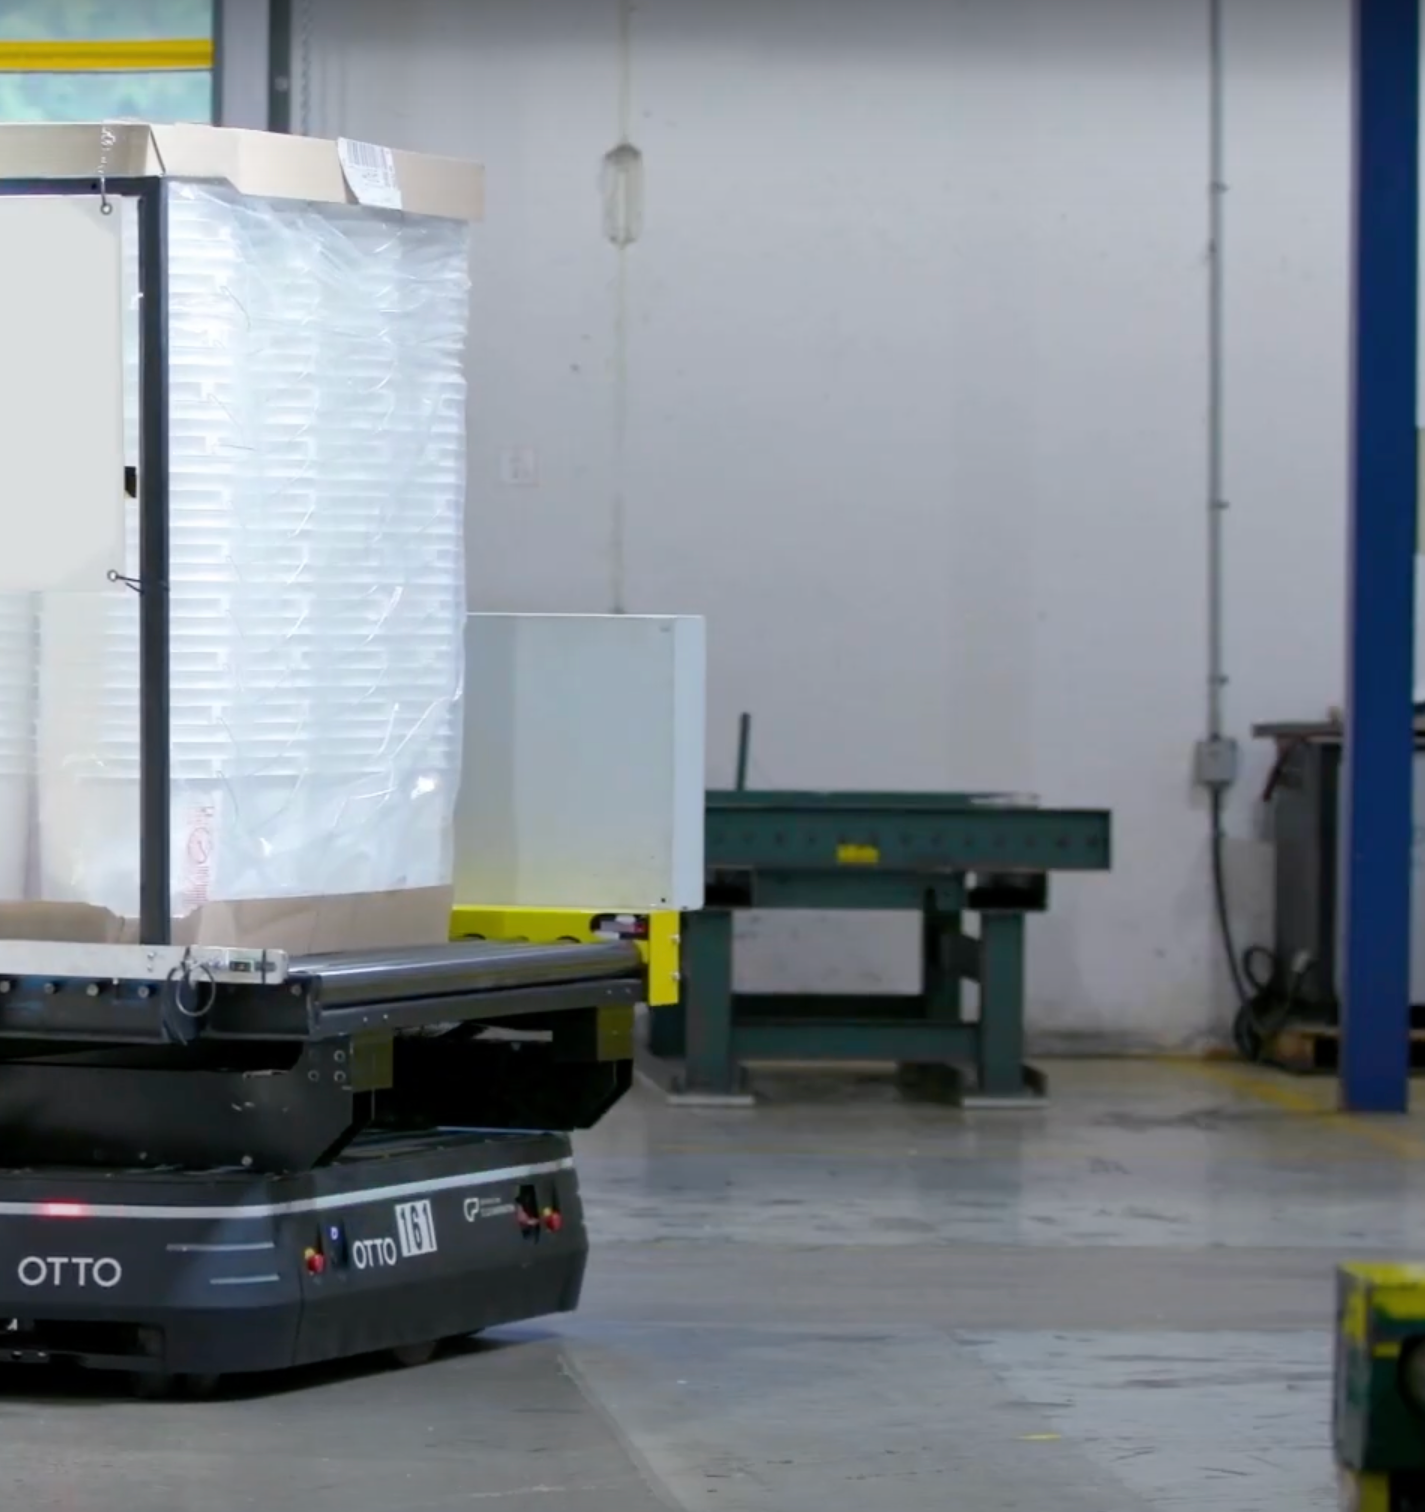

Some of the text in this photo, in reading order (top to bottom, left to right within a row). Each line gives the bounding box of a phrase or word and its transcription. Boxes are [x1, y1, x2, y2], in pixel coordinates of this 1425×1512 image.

[399, 1202, 435, 1255] 161
[352, 1237, 397, 1270] OTTO
[17, 1255, 123, 1288] OTTO
